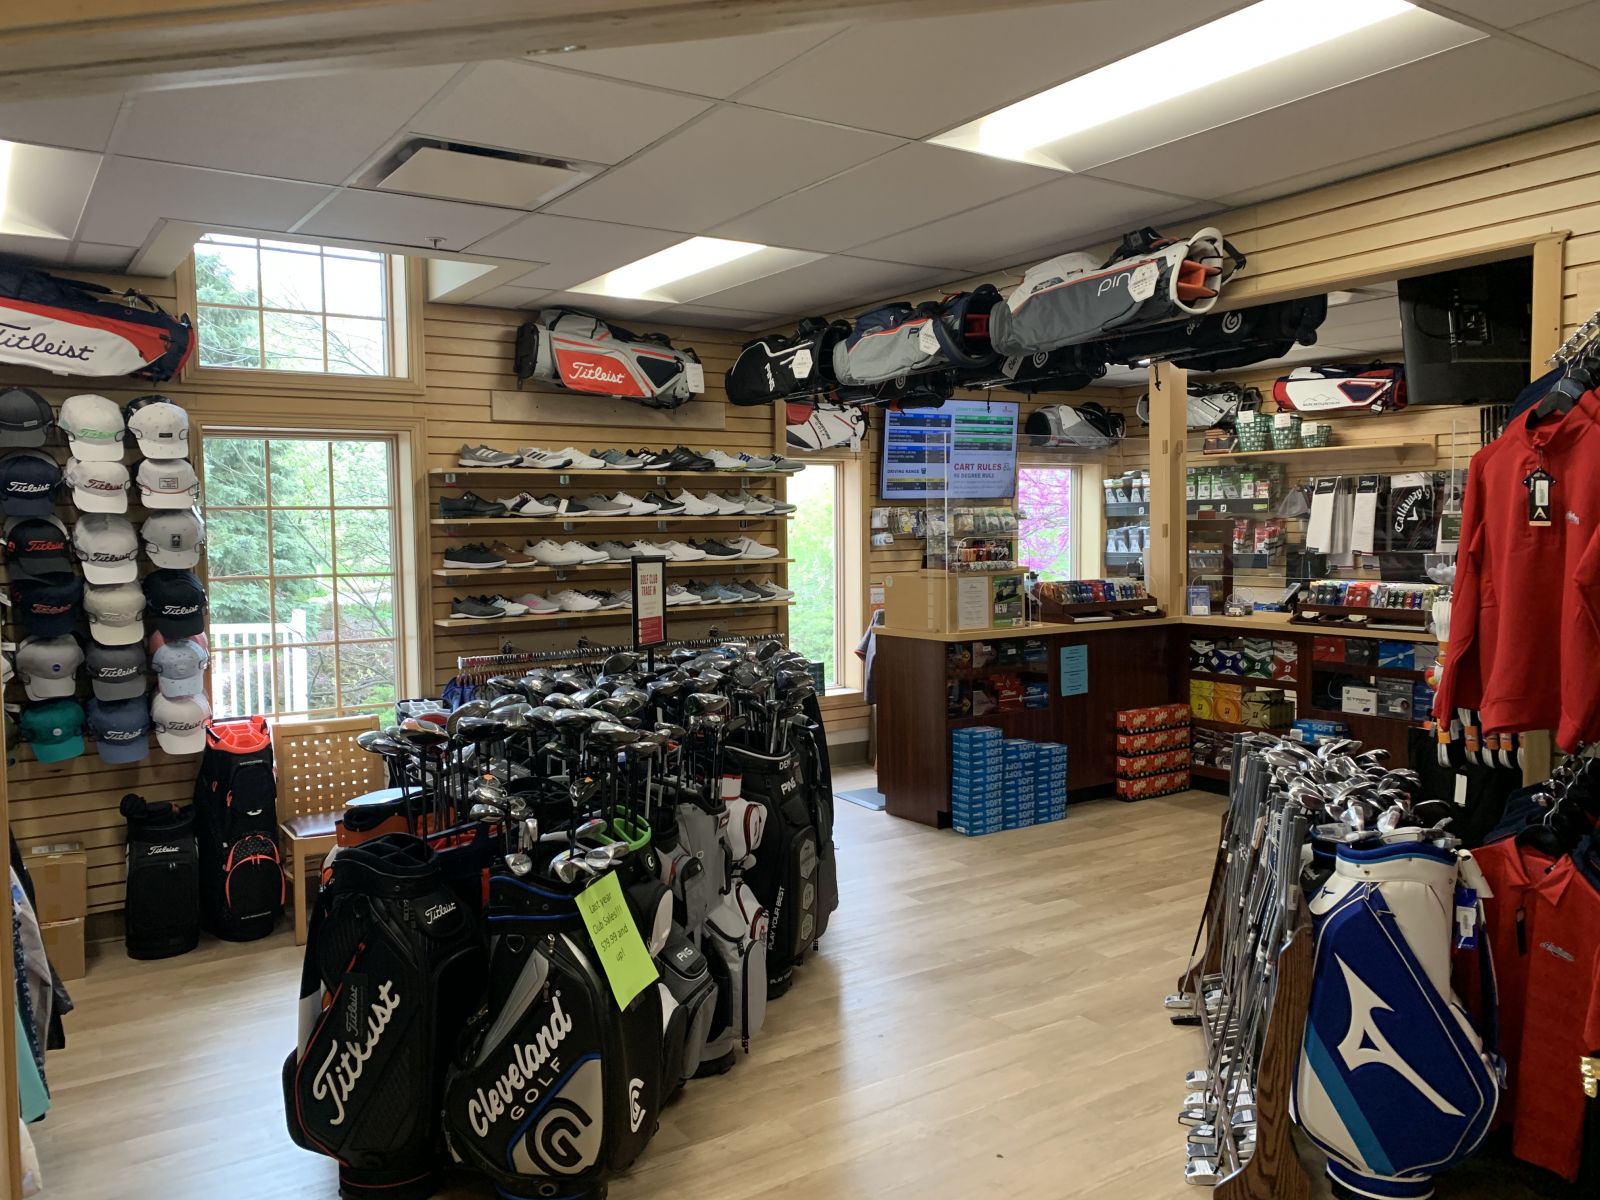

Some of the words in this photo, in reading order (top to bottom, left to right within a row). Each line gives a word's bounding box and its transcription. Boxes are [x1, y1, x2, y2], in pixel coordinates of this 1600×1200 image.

[569, 361, 626, 385] Titleist
[953, 463, 975, 471] CART
[977, 463, 1002, 471] RULES
[6, 480, 50, 493] Titleist
[84, 479, 124, 491] Titleist
[1395, 488, 1423, 532] Callaway
[25, 540, 64, 552] Titleist
[90, 552, 130, 563] Titleist
[162, 604, 199, 616] Titleist
[994, 604, 1008, 614] NEW
[99, 666, 138, 678] Titleist
[167, 719, 202, 731] Titleist
[1312, 723, 1334, 732] SOFT
[104, 729, 142, 741] Titleist
[985, 748, 1002, 756] SOFT
[985, 756, 1002, 765] SOFT
[985, 765, 1002, 773] SOFT
[1051, 763, 1067, 771] SOFT
[985, 773, 1002, 782] SOFT
[1018, 777, 1034, 785] SOFT
[1051, 771, 1067, 779] SOFT
[781, 777, 796, 796] PING
[985, 782, 1002, 790] SOFT
[1018, 793, 1034, 801] SOFT
[147, 845, 180, 856] Titleist
[776, 885, 785, 906] BEST
[589, 900, 600, 914] Last
[600, 892, 612, 907] year
[425, 902, 456, 925] Titleist
[773, 905, 781, 930] YOUR
[592, 920, 604, 935] Club
[618, 923, 629, 938] and
[768, 929, 777, 951] PLAY
[616, 947, 626, 962] up!
[345, 984, 359, 1037] Titleist
[468, 996, 573, 1138] Cleveland
[510, 1057, 562, 1121] GOLF
